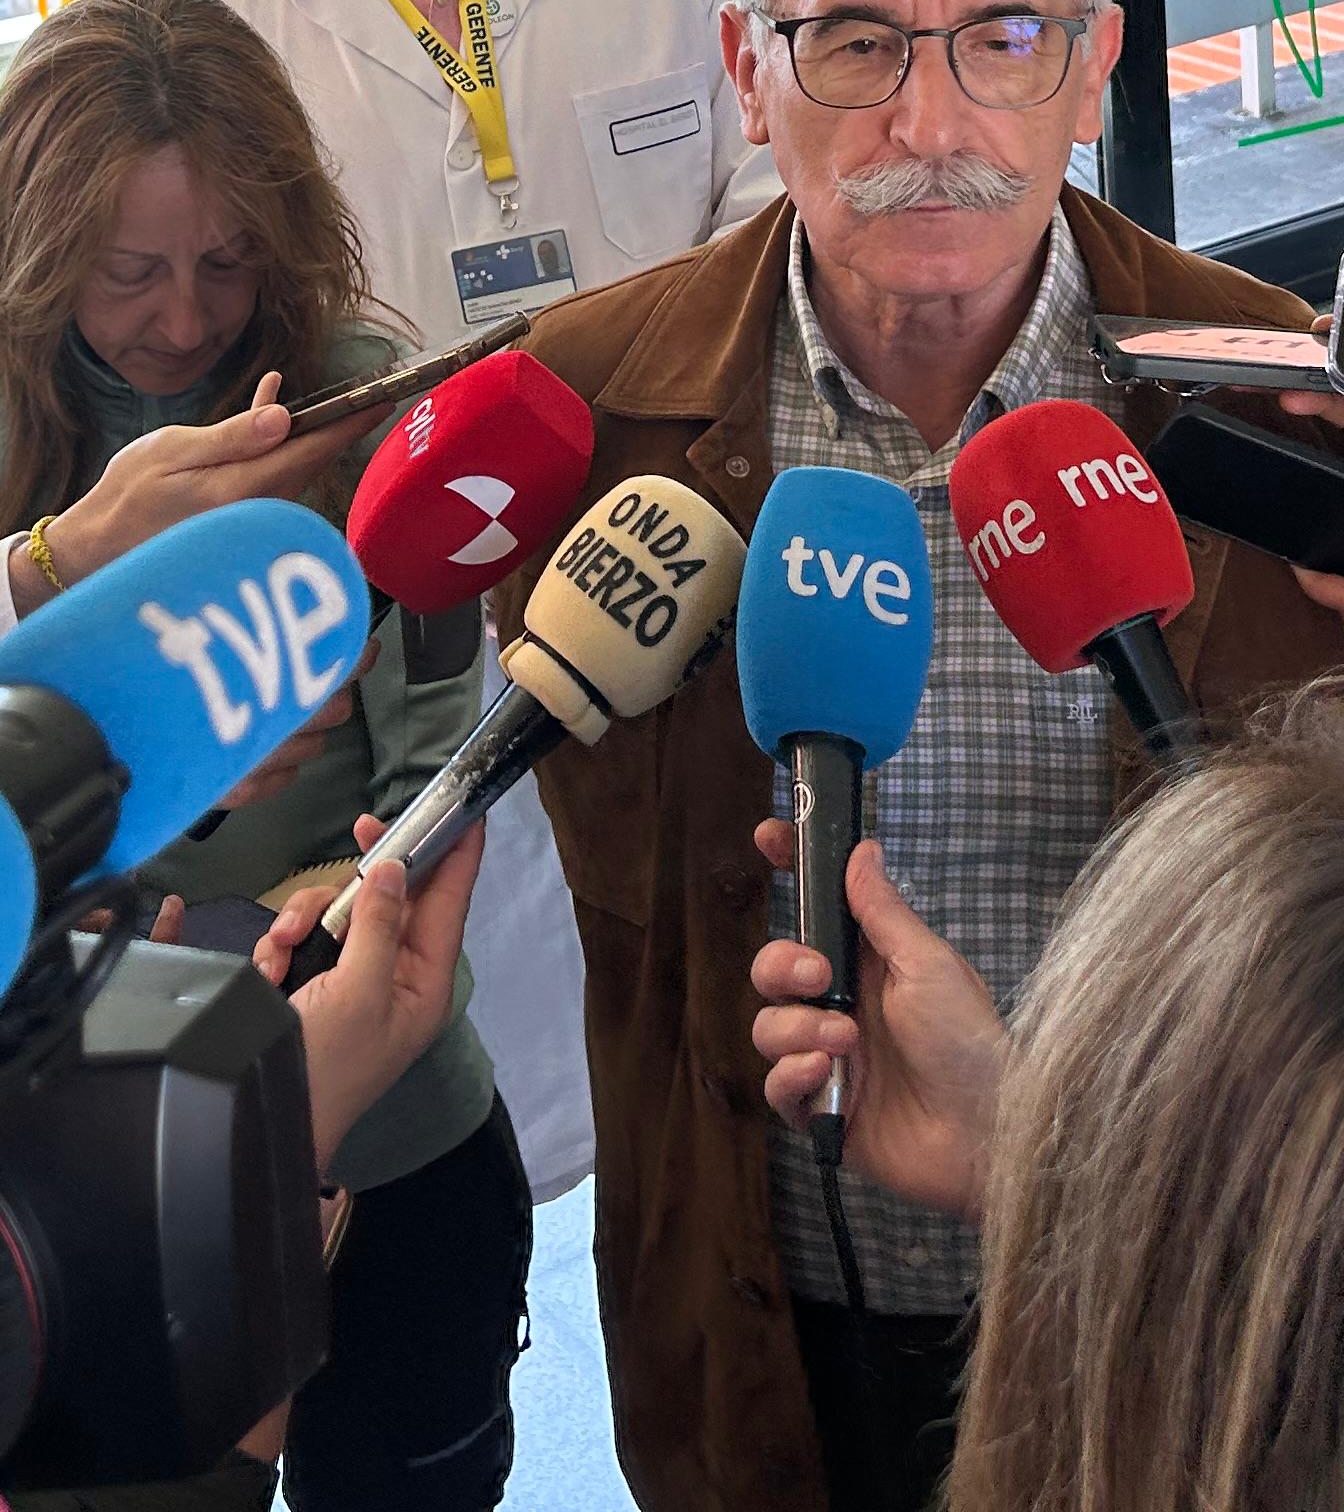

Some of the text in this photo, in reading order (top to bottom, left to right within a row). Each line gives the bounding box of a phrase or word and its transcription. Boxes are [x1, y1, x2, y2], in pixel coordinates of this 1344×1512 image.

[416, 25, 478, 93] GERENTE
[465, 2, 495, 89] GERENTE
[1057, 453, 1158, 508] rne
[608, 492, 707, 589] ONDA
[781, 534, 912, 626] tve
[968, 498, 1046, 583] rne
[555, 527, 679, 648] BIERZO
[138, 550, 351, 745] tve
